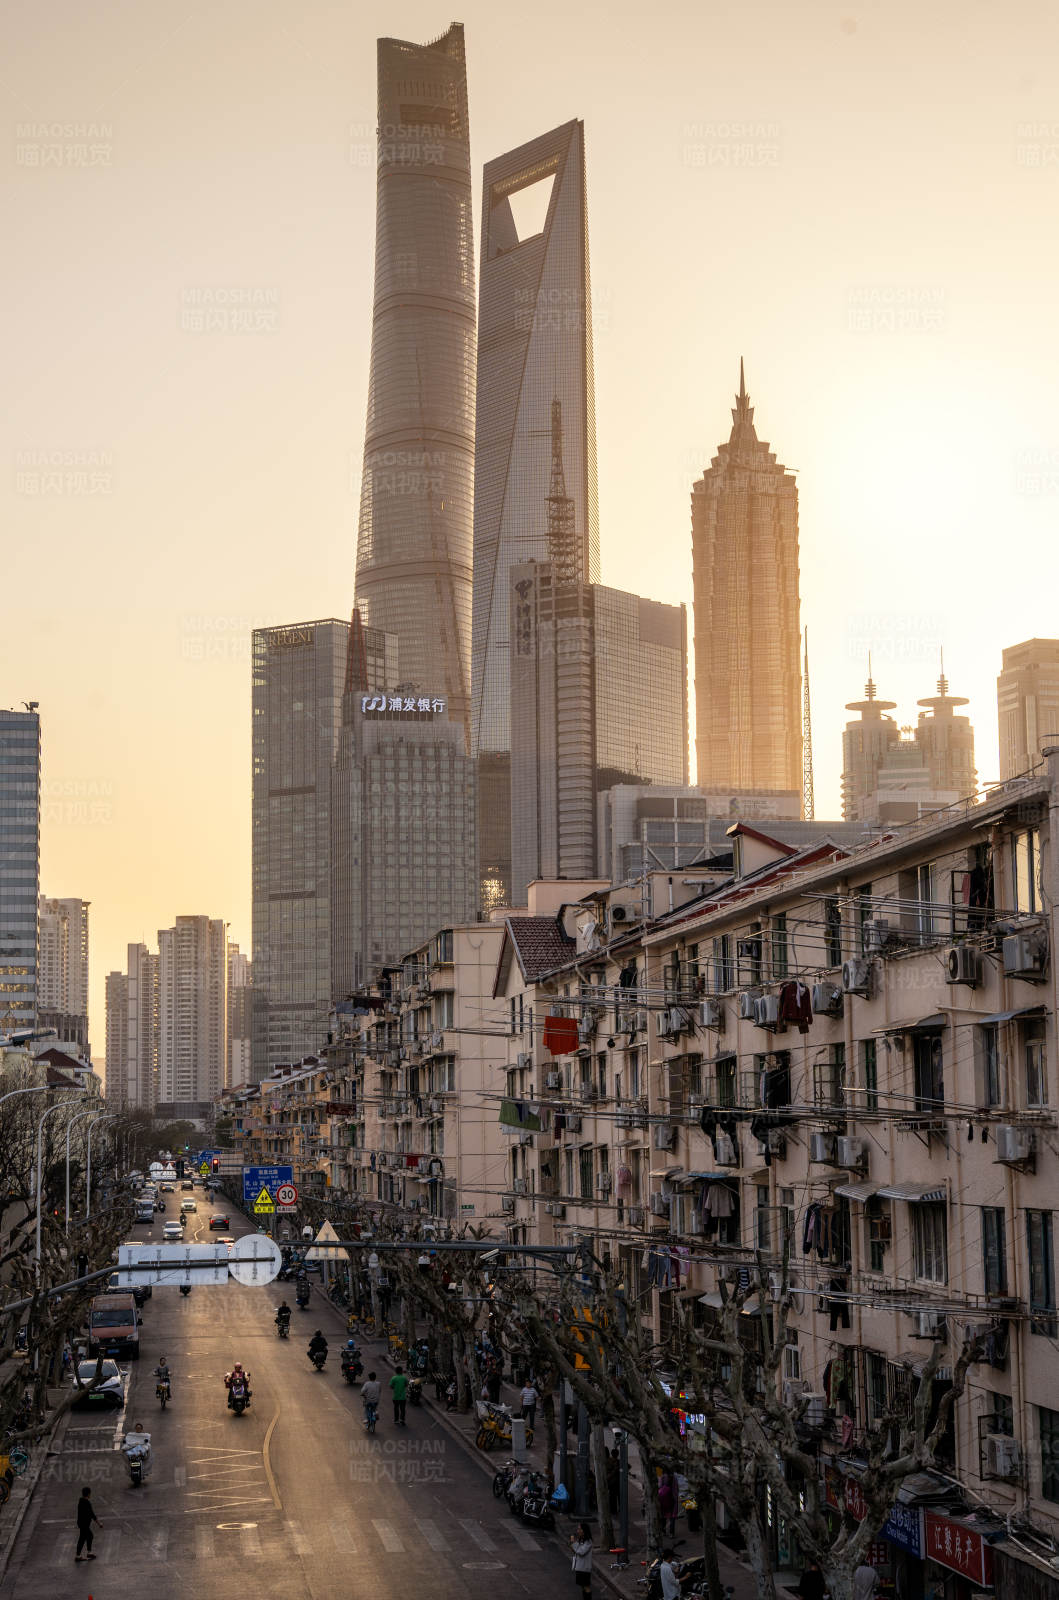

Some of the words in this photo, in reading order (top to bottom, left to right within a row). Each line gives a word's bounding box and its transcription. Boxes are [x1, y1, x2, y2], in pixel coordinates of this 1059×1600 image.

[269, 629, 313, 646] REGENT
[388, 697, 446, 713] 浦发银行
[281, 1190, 293, 1200] 30
